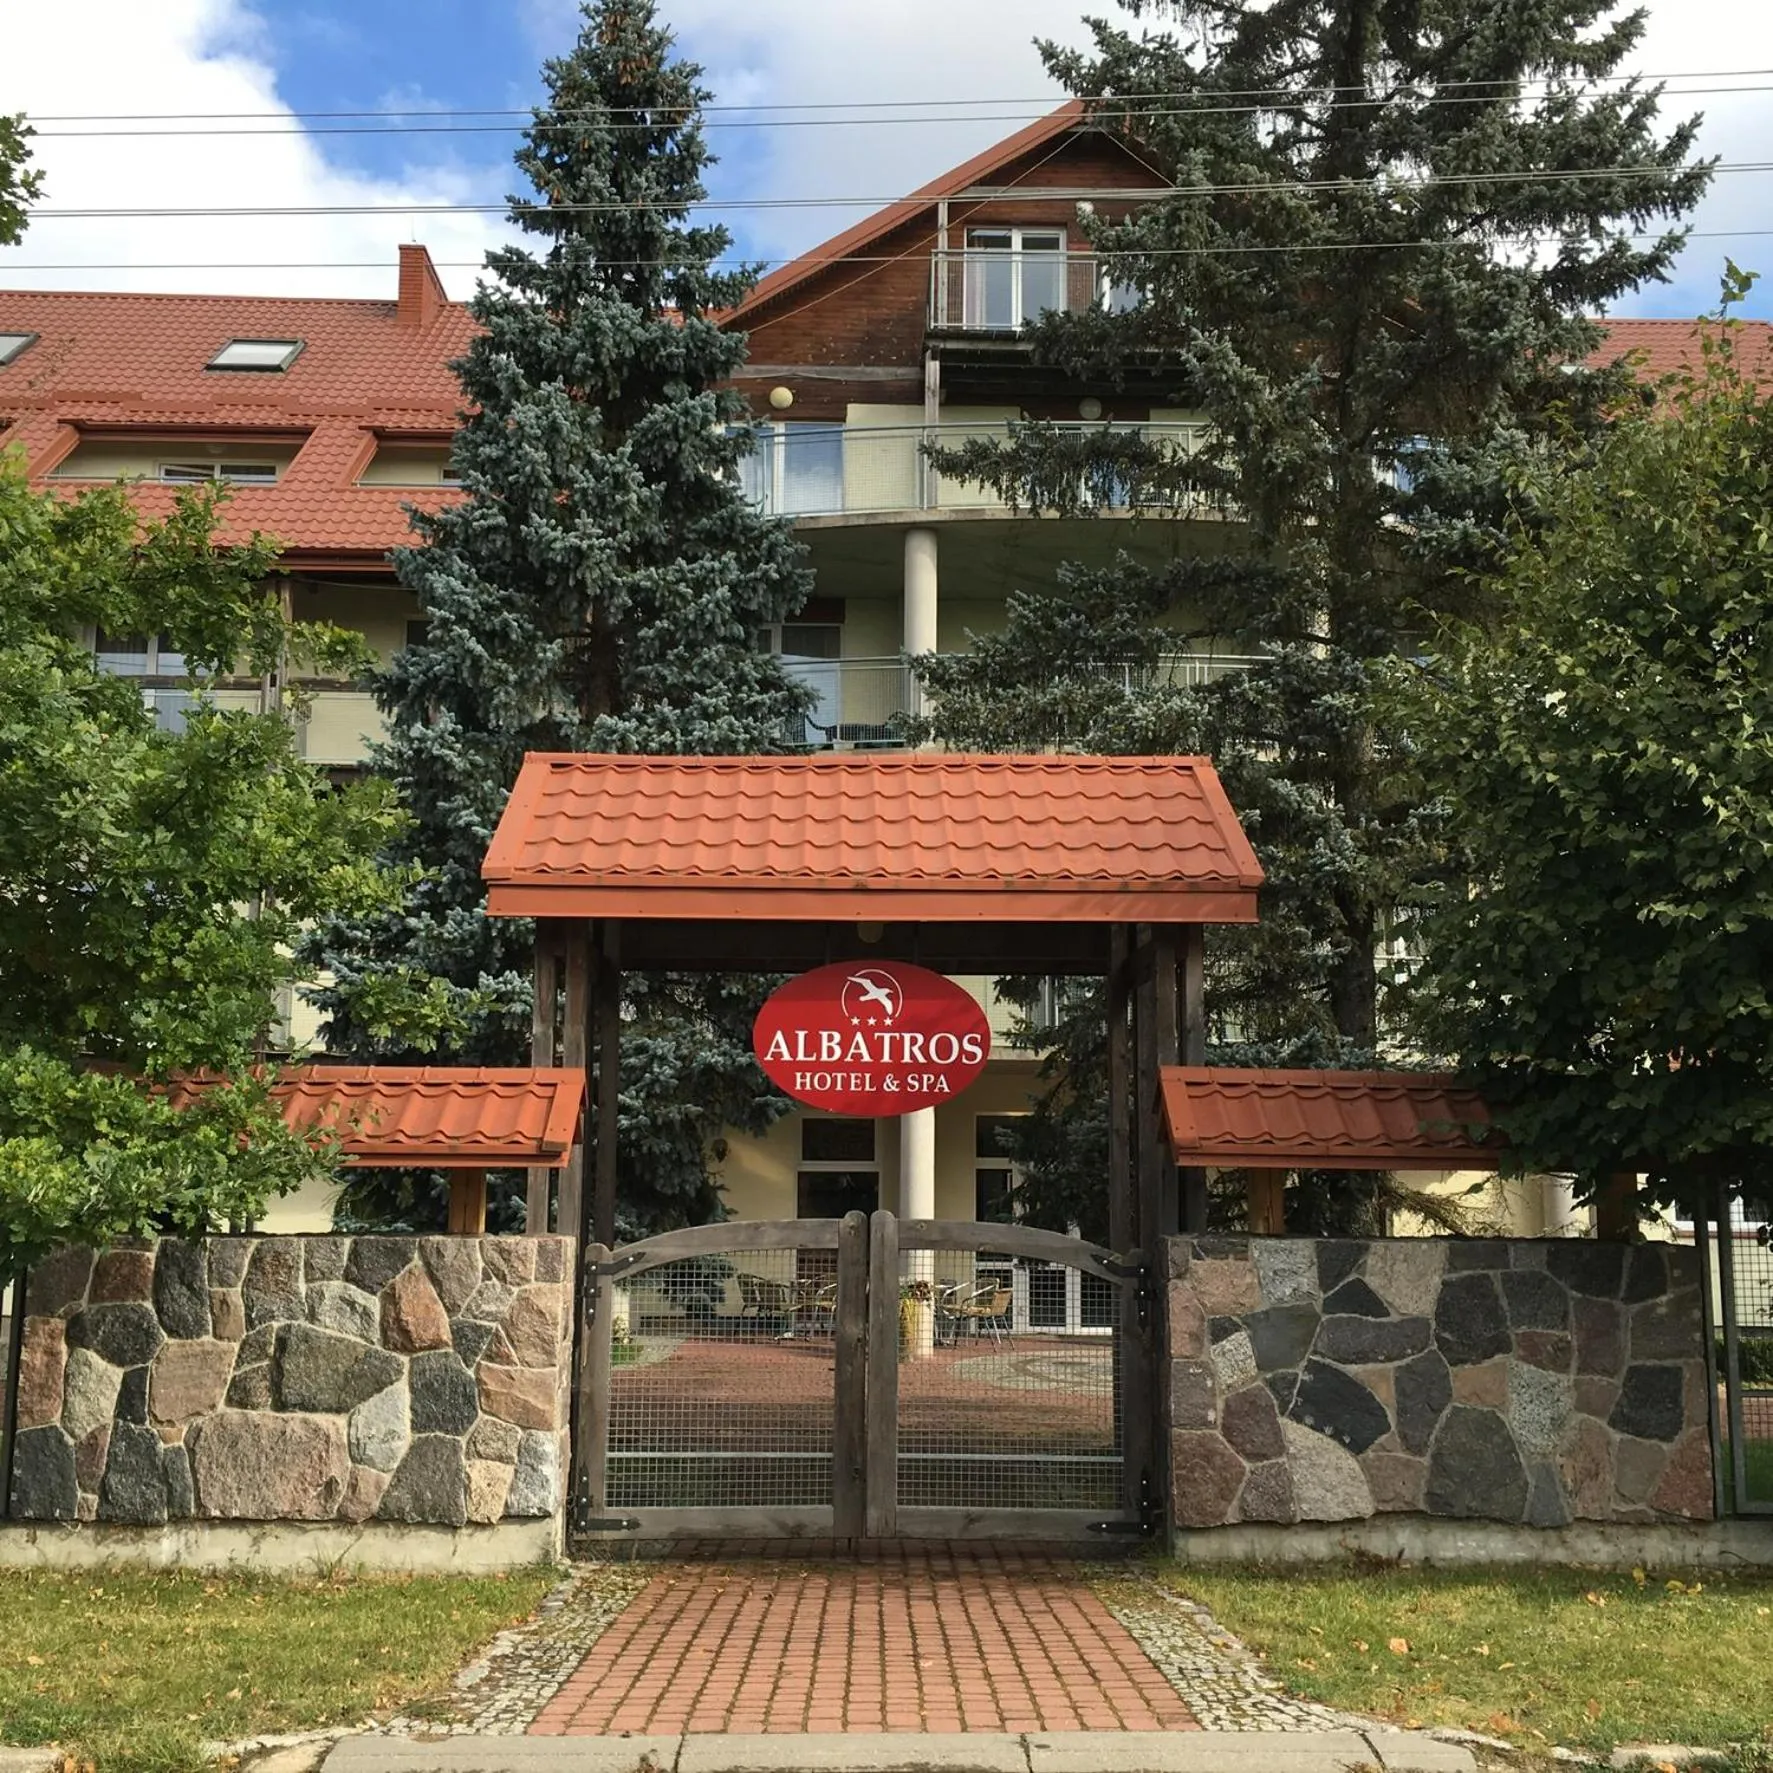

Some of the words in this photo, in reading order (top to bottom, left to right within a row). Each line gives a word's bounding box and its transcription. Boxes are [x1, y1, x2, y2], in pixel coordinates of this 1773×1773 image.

[764, 1030, 983, 1064] ALBATROS
[795, 1072, 876, 1092] HOTEL
[882, 1074, 900, 1092] &
[906, 1074, 951, 1092] SPA
